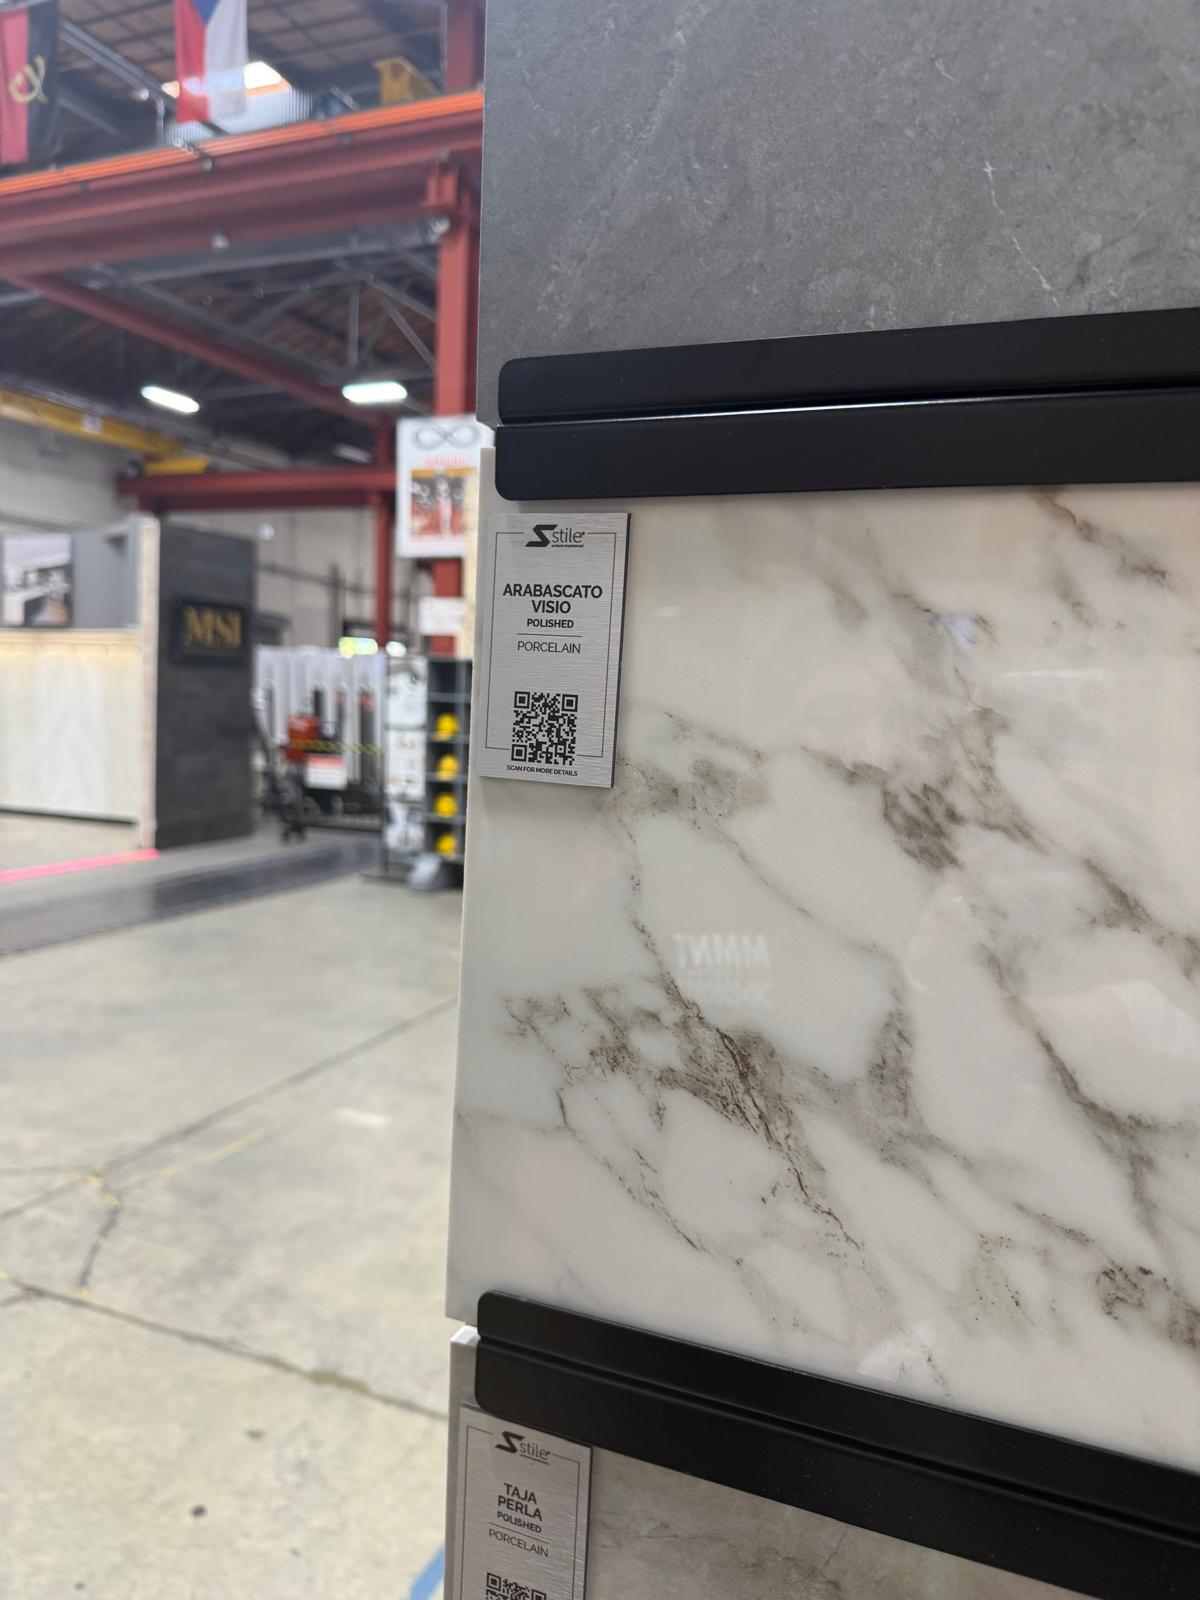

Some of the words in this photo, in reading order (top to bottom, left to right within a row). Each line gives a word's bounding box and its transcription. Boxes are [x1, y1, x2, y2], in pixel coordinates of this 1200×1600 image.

[503, 583, 603, 599] ARABASCATO
[531, 600, 571, 614] VISIO
[526, 618, 574, 629] POLISHED
[517, 641, 581, 654] PORCELAIN
[506, 764, 522, 772] SCAN
[536, 767, 553, 775] MORE
[553, 769, 578, 777] DETAILS
[503, 1482, 538, 1505] TAJA
[497, 1494, 543, 1521] PERLA
[496, 1511, 542, 1534] POLISHED
[488, 1528, 549, 1558] PORCELAIN
